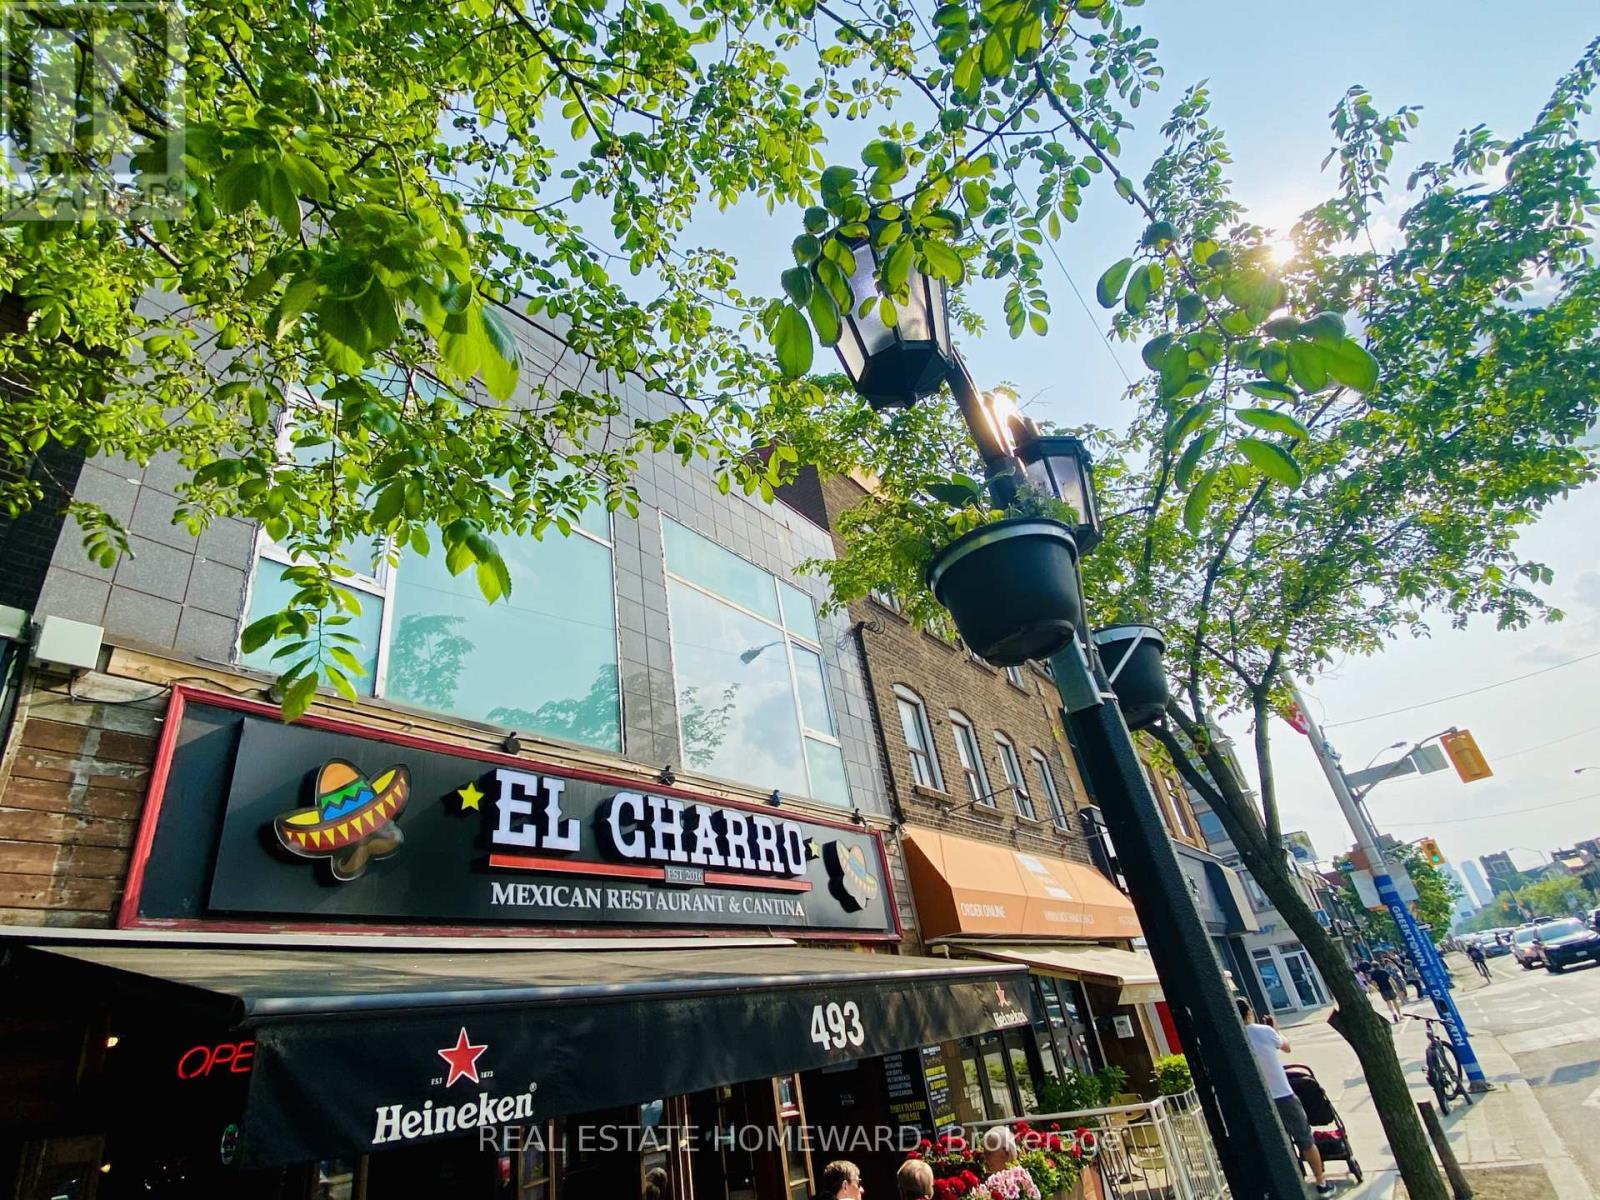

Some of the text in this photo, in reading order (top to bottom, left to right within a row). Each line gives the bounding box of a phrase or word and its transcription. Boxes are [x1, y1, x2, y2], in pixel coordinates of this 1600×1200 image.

[492, 768, 808, 876] EL CHARRO
[667, 869, 684, 880] EST
[491, 882, 805, 917] MEXICAN RESTAURANT & CANTINA
[1391, 904, 1428, 968] GREEKTOWN
[810, 1001, 865, 1051] 493
[430, 1076, 443, 1086] EST
